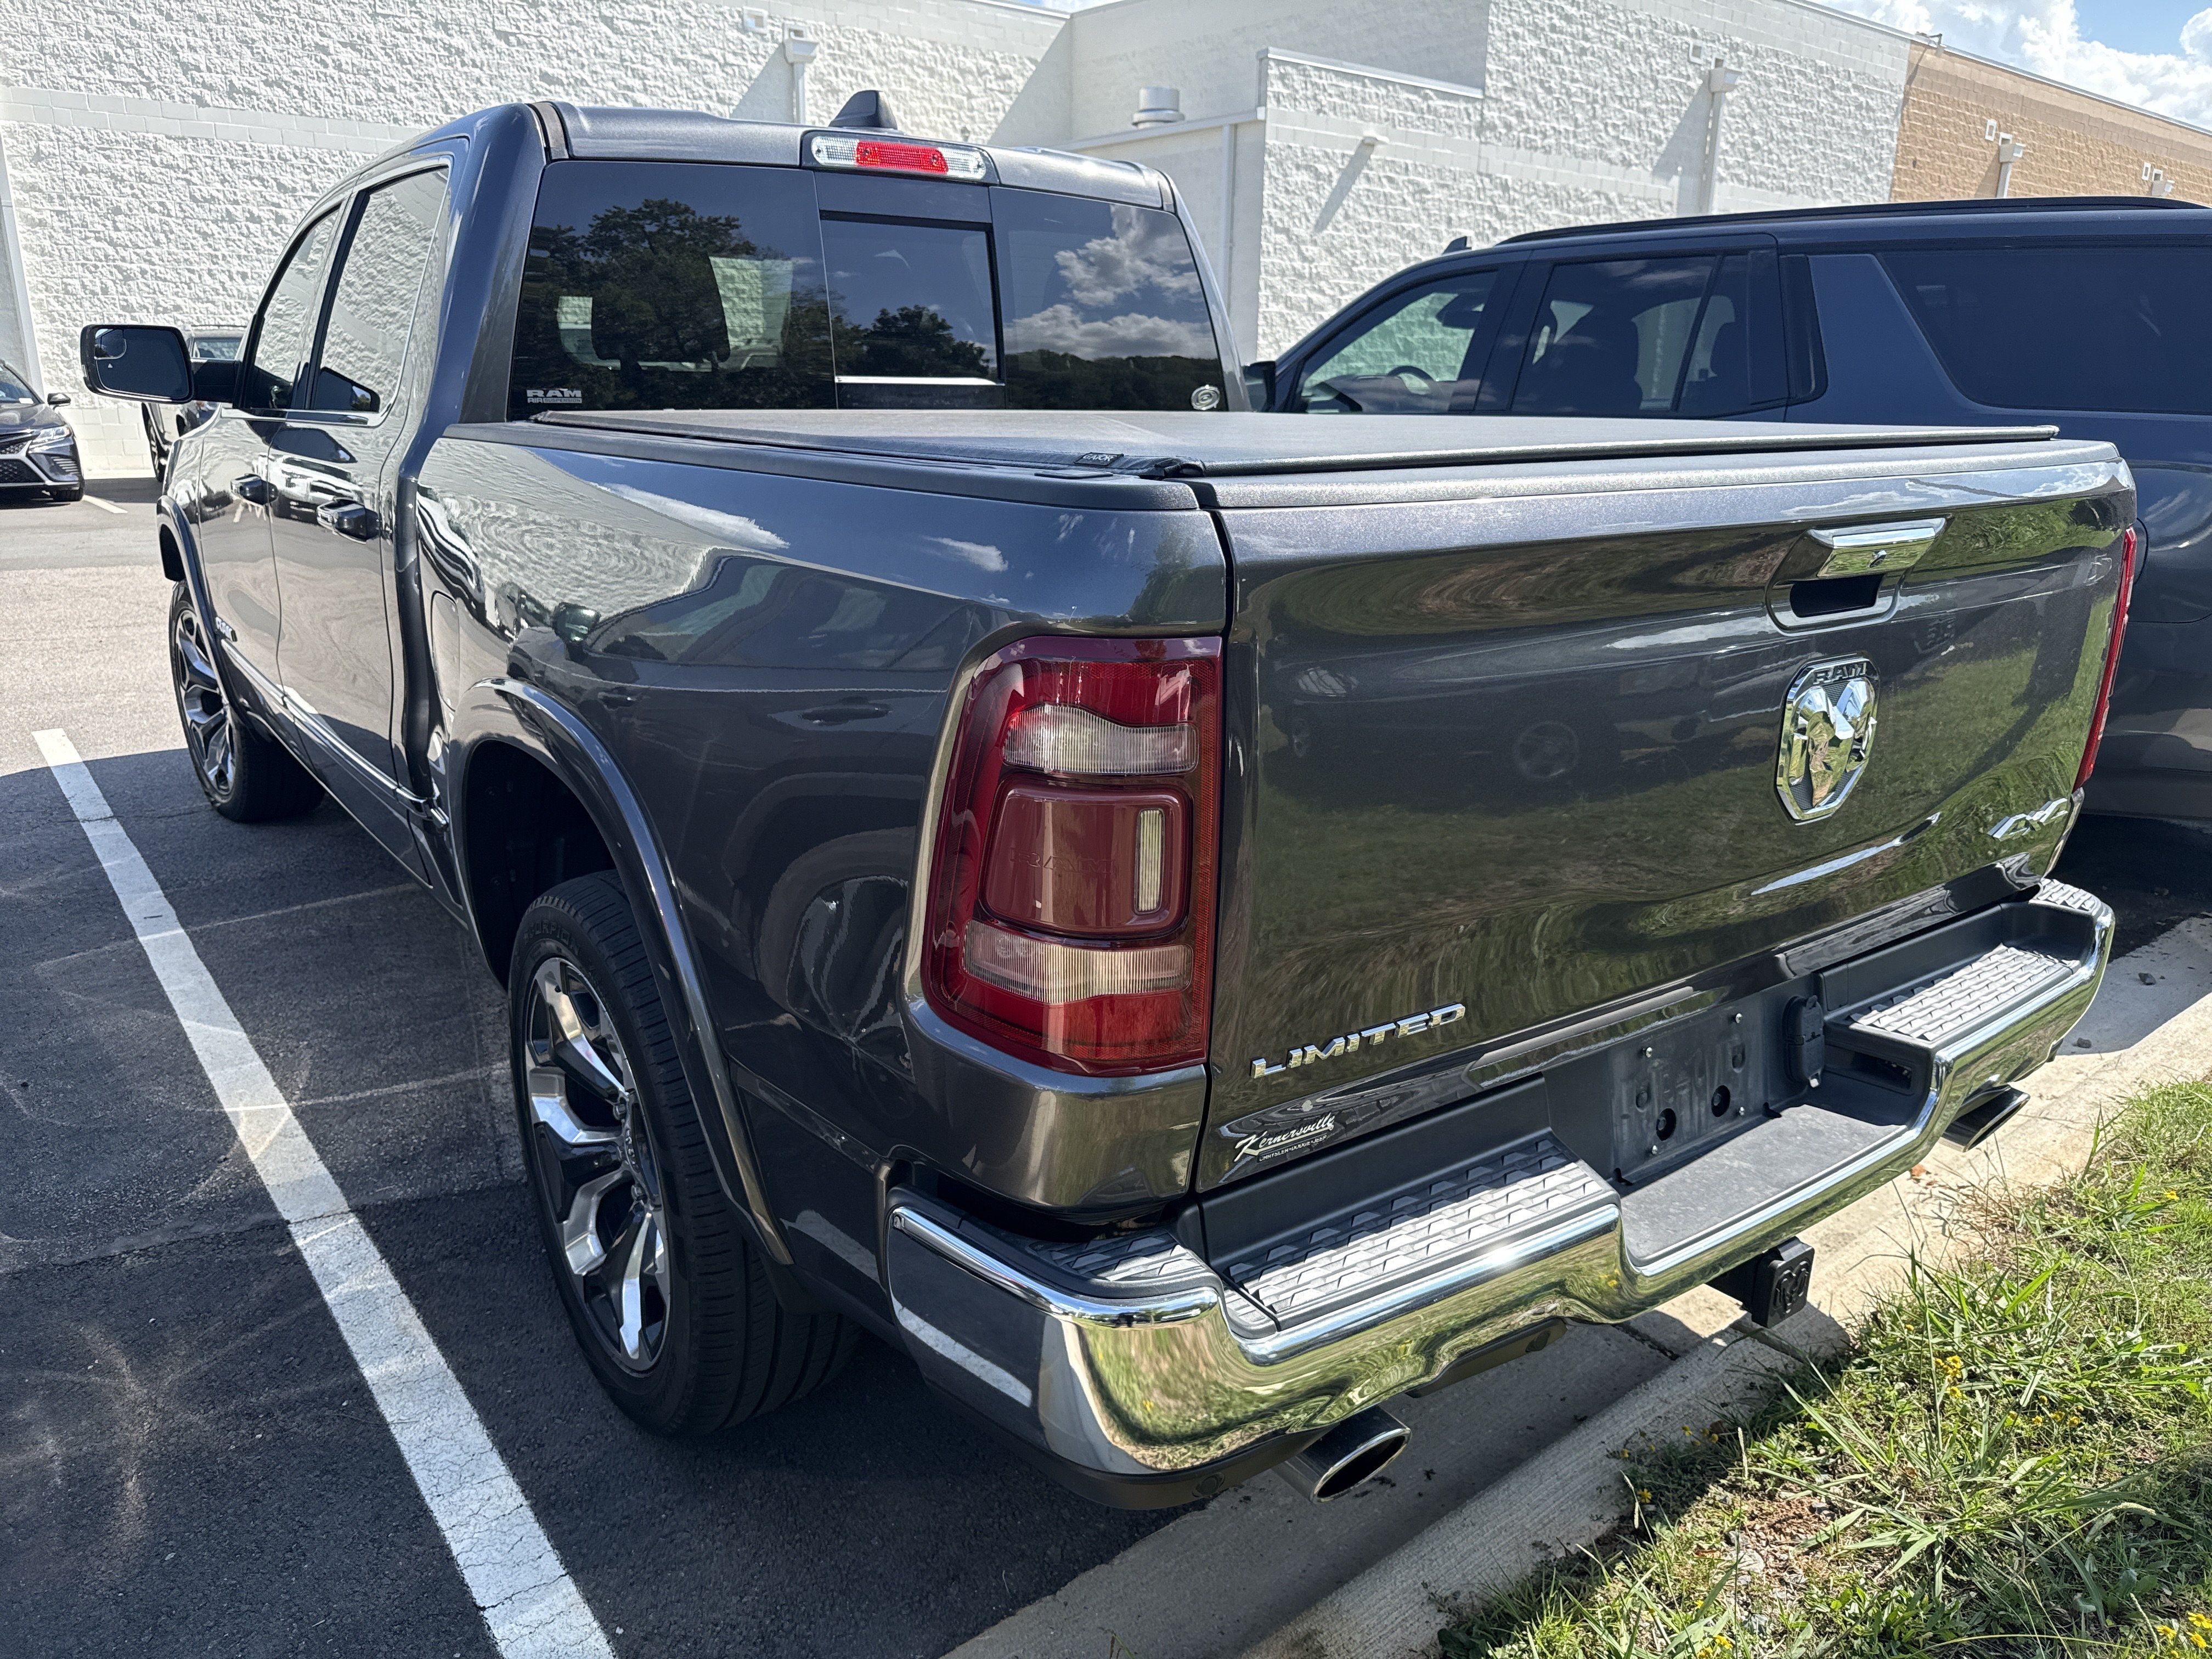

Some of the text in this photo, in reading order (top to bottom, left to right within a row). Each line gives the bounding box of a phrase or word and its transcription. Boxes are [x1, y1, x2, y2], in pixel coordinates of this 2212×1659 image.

[1813, 662, 1866, 685] RAM
[1009, 847, 1115, 874] RAM
[1251, 1003, 1465, 1079] LIMITED
[1233, 1112, 1335, 1162] Kernersville
